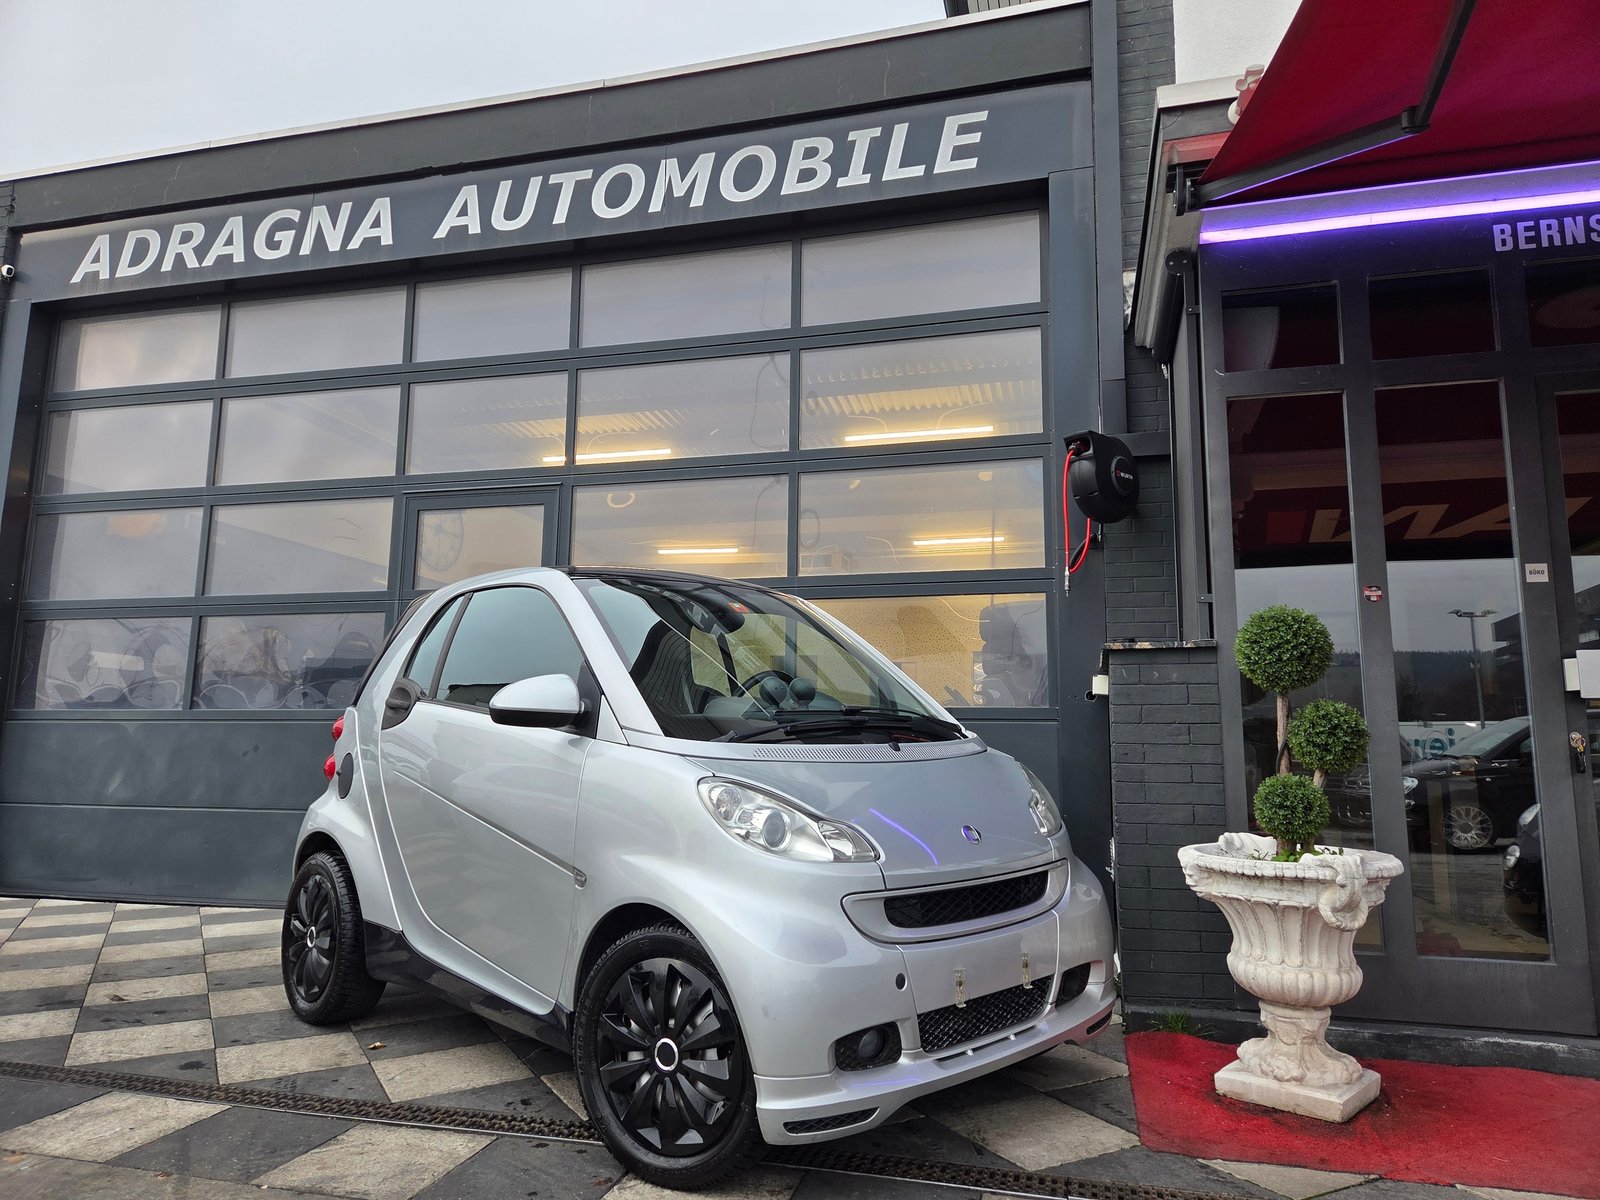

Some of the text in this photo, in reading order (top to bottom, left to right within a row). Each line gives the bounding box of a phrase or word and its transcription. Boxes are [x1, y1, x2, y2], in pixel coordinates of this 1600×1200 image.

[70, 109, 989, 284] ADRAGNA AUTOMOBILE
[1493, 213, 1600, 252] BERNS
[1528, 568, 1545, 576] BÜRO
